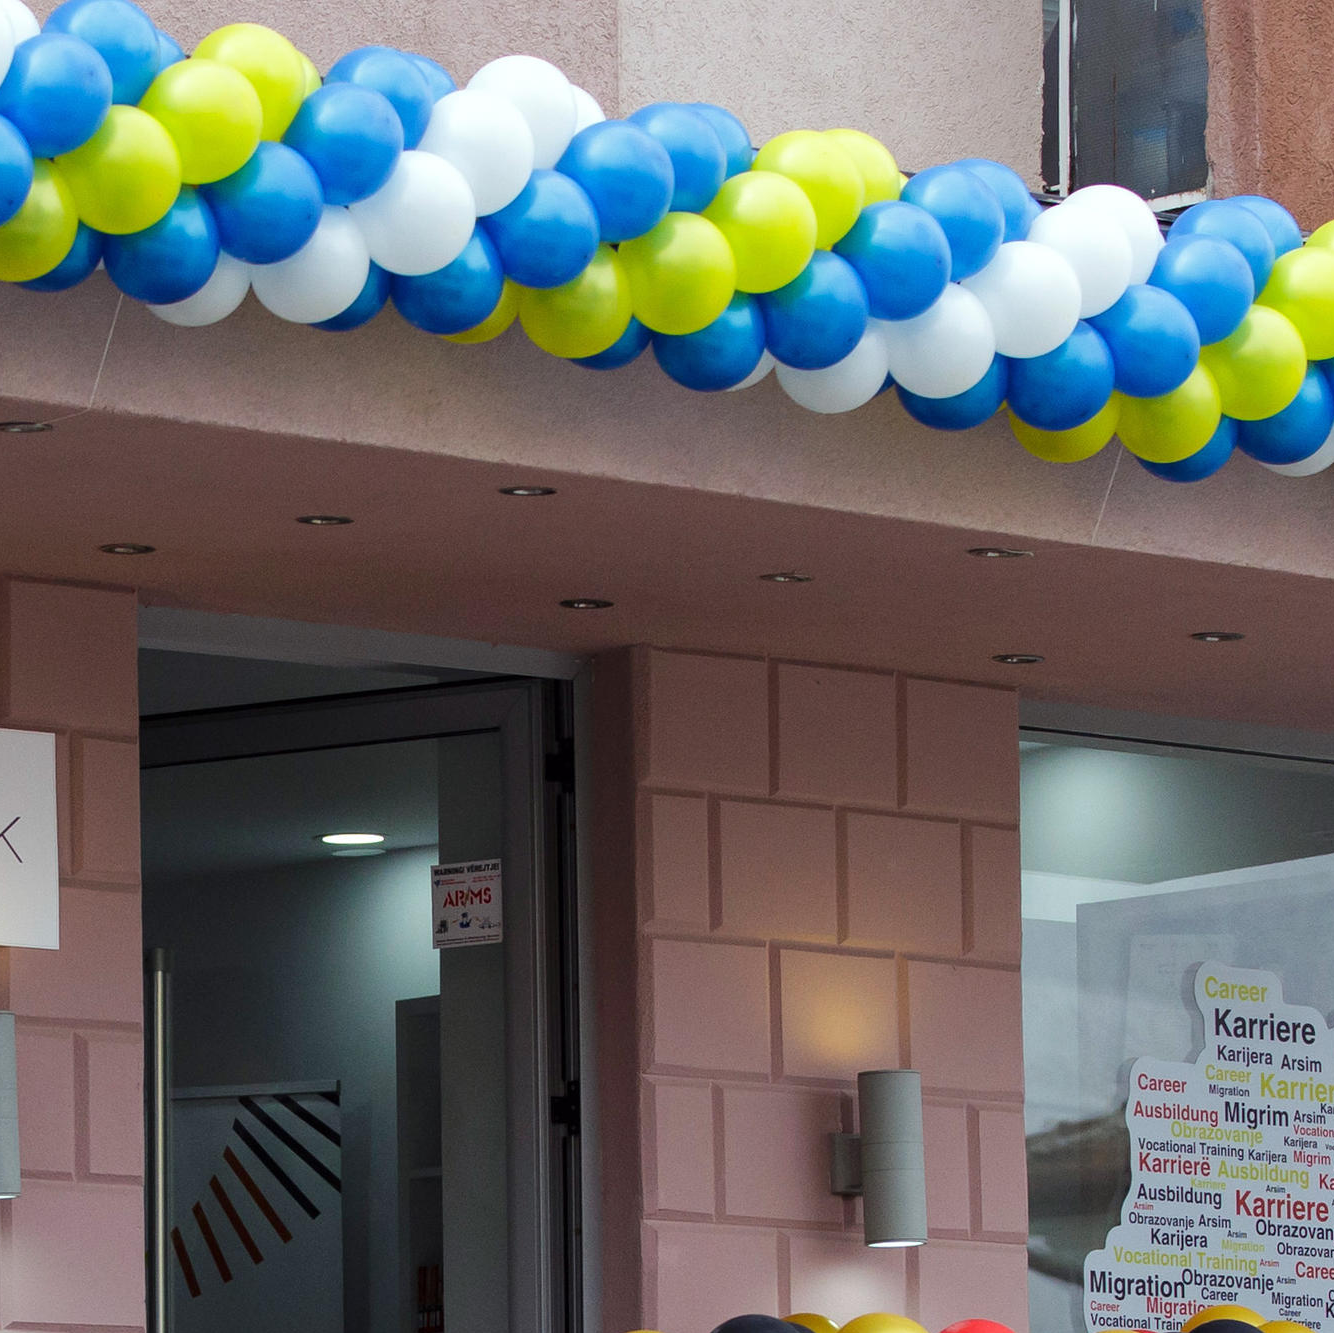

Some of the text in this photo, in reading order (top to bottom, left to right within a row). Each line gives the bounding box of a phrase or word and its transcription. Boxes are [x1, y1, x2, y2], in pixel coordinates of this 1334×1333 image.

[1205, 975, 1268, 1002] Career
[1215, 1008, 1316, 1045] Karriere
[1217, 1045, 1273, 1067] Karijera
[1281, 1054, 1322, 1073] Arsim
[1137, 1073, 1187, 1093] Career
[1205, 1064, 1251, 1083] Career
[1209, 1084, 1250, 1098] Migration
[1133, 1101, 1219, 1127] Ausbildung
[1224, 1101, 1289, 1130] Migrim
[1293, 1110, 1326, 1124] Arsim
[1171, 1121, 1263, 1147] Obrazovanje
[1284, 1136, 1318, 1150] Karijera
[1138, 1137, 1244, 1160] Vocational Training
[1248, 1150, 1287, 1165] Karijera
[1293, 1151, 1331, 1167] Migrim
[1139, 1152, 1211, 1176] Karrierë
[1218, 1160, 1309, 1190] Ausbildung
[1137, 1183, 1222, 1210] Ausbildung
[1235, 1189, 1329, 1222] Karriere
[1129, 1212, 1194, 1230] Obrazovanje
[1198, 1214, 1231, 1229] Arsim
[1151, 1228, 1208, 1250] Karijera
[1113, 1246, 1257, 1276] Vocational Training
[1090, 1270, 1185, 1300] Migration
[1182, 1269, 1274, 1294] Obrazovanje
[1201, 1287, 1238, 1302] Career
[1271, 1292, 1323, 1309] Migration
[1090, 1300, 1119, 1312] Career
[1146, 1297, 1213, 1318] Migratio
[1279, 1308, 1301, 1317] Career
[1090, 1313, 1186, 1330] Vocational Train
